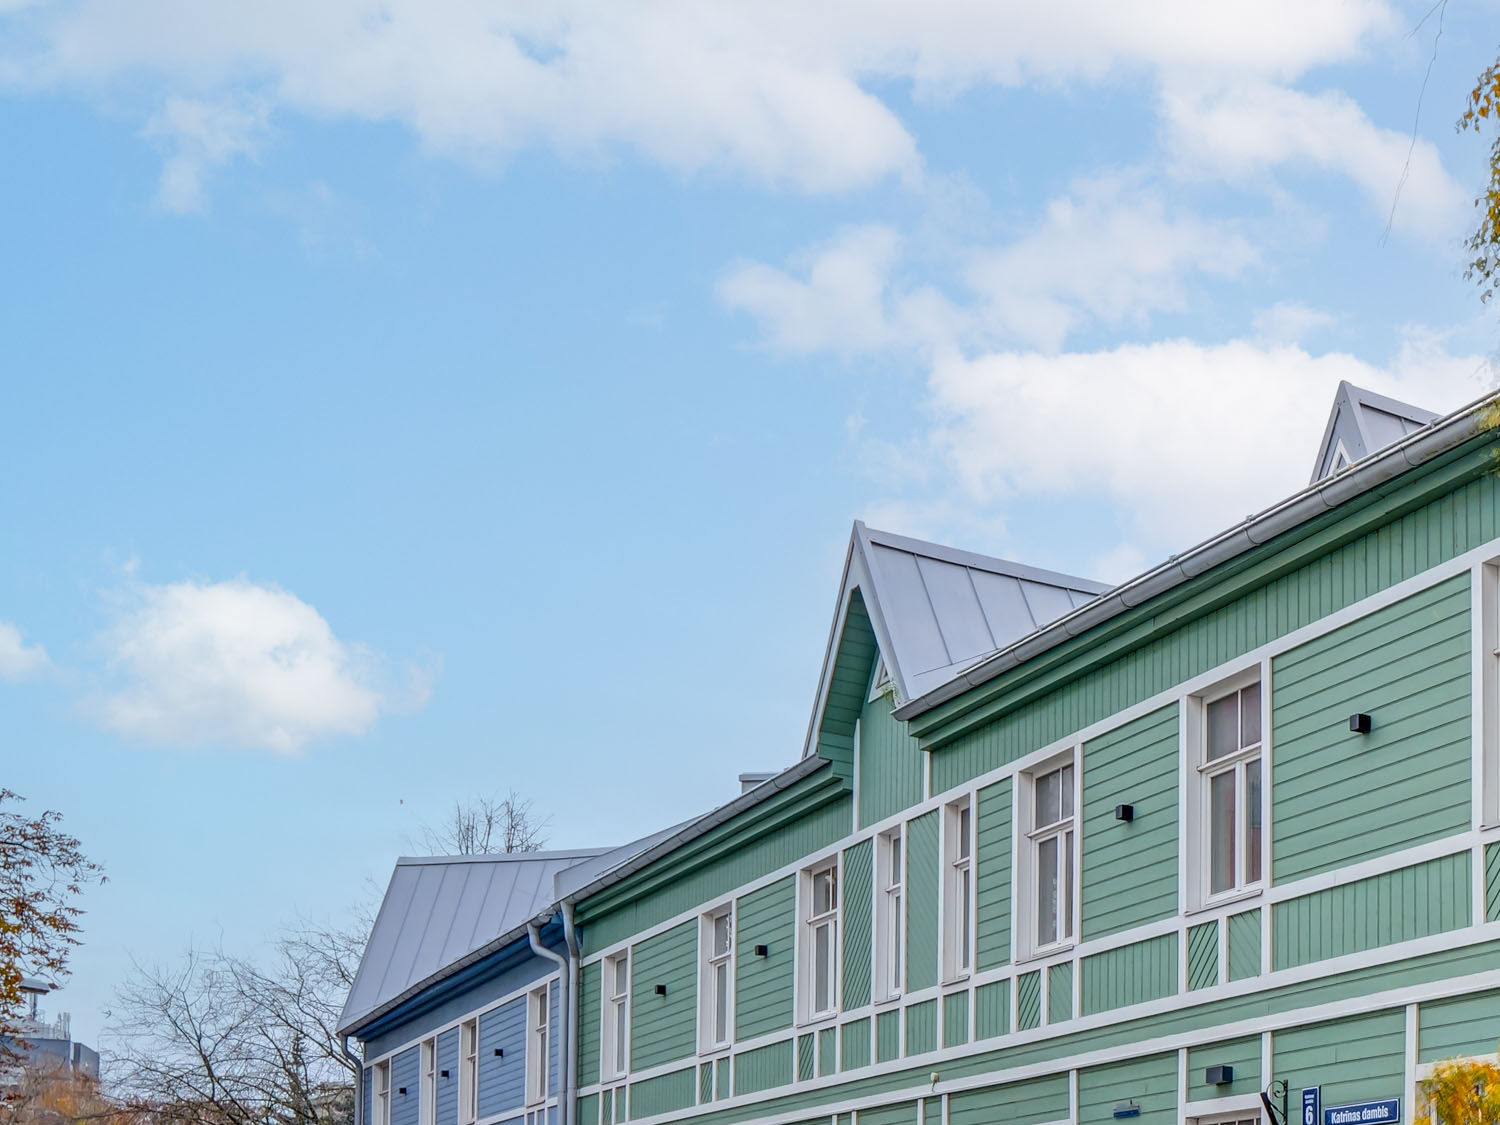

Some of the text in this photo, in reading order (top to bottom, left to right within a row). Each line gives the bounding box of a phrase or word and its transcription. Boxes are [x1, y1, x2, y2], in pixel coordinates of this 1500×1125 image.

[1305, 1105, 1313, 1125] 6
[1331, 1104, 1389, 1124] Katrīnas dambis
